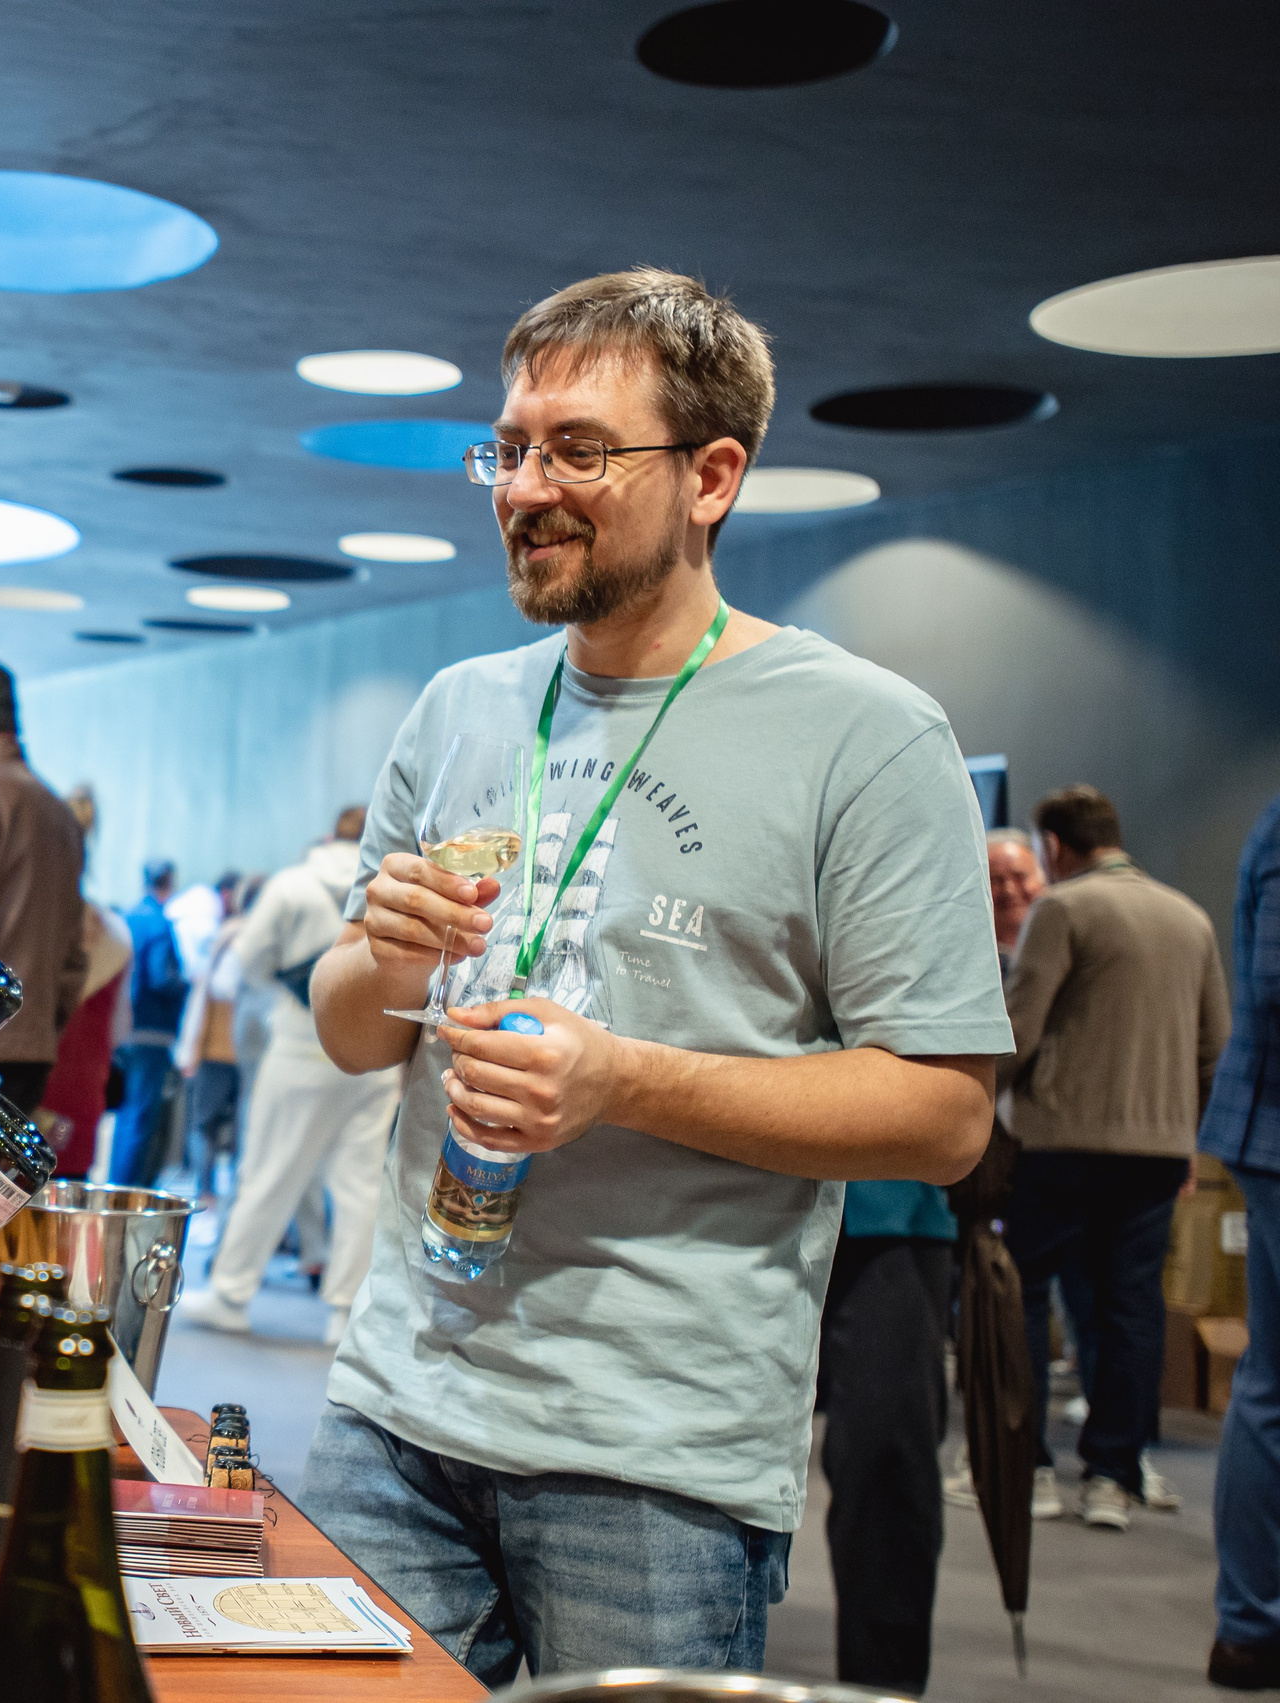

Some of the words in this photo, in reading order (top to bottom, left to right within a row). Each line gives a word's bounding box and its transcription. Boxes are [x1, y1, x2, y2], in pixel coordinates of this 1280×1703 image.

[628, 768, 703, 855] WEAVES
[649, 894, 706, 938] SEA
[619, 951, 652, 968] Time
[615, 965, 629, 977] to
[633, 968, 671, 990] Travel
[466, 1165, 507, 1182] MRIYA
[148, 1583, 174, 1605] СВЕТ
